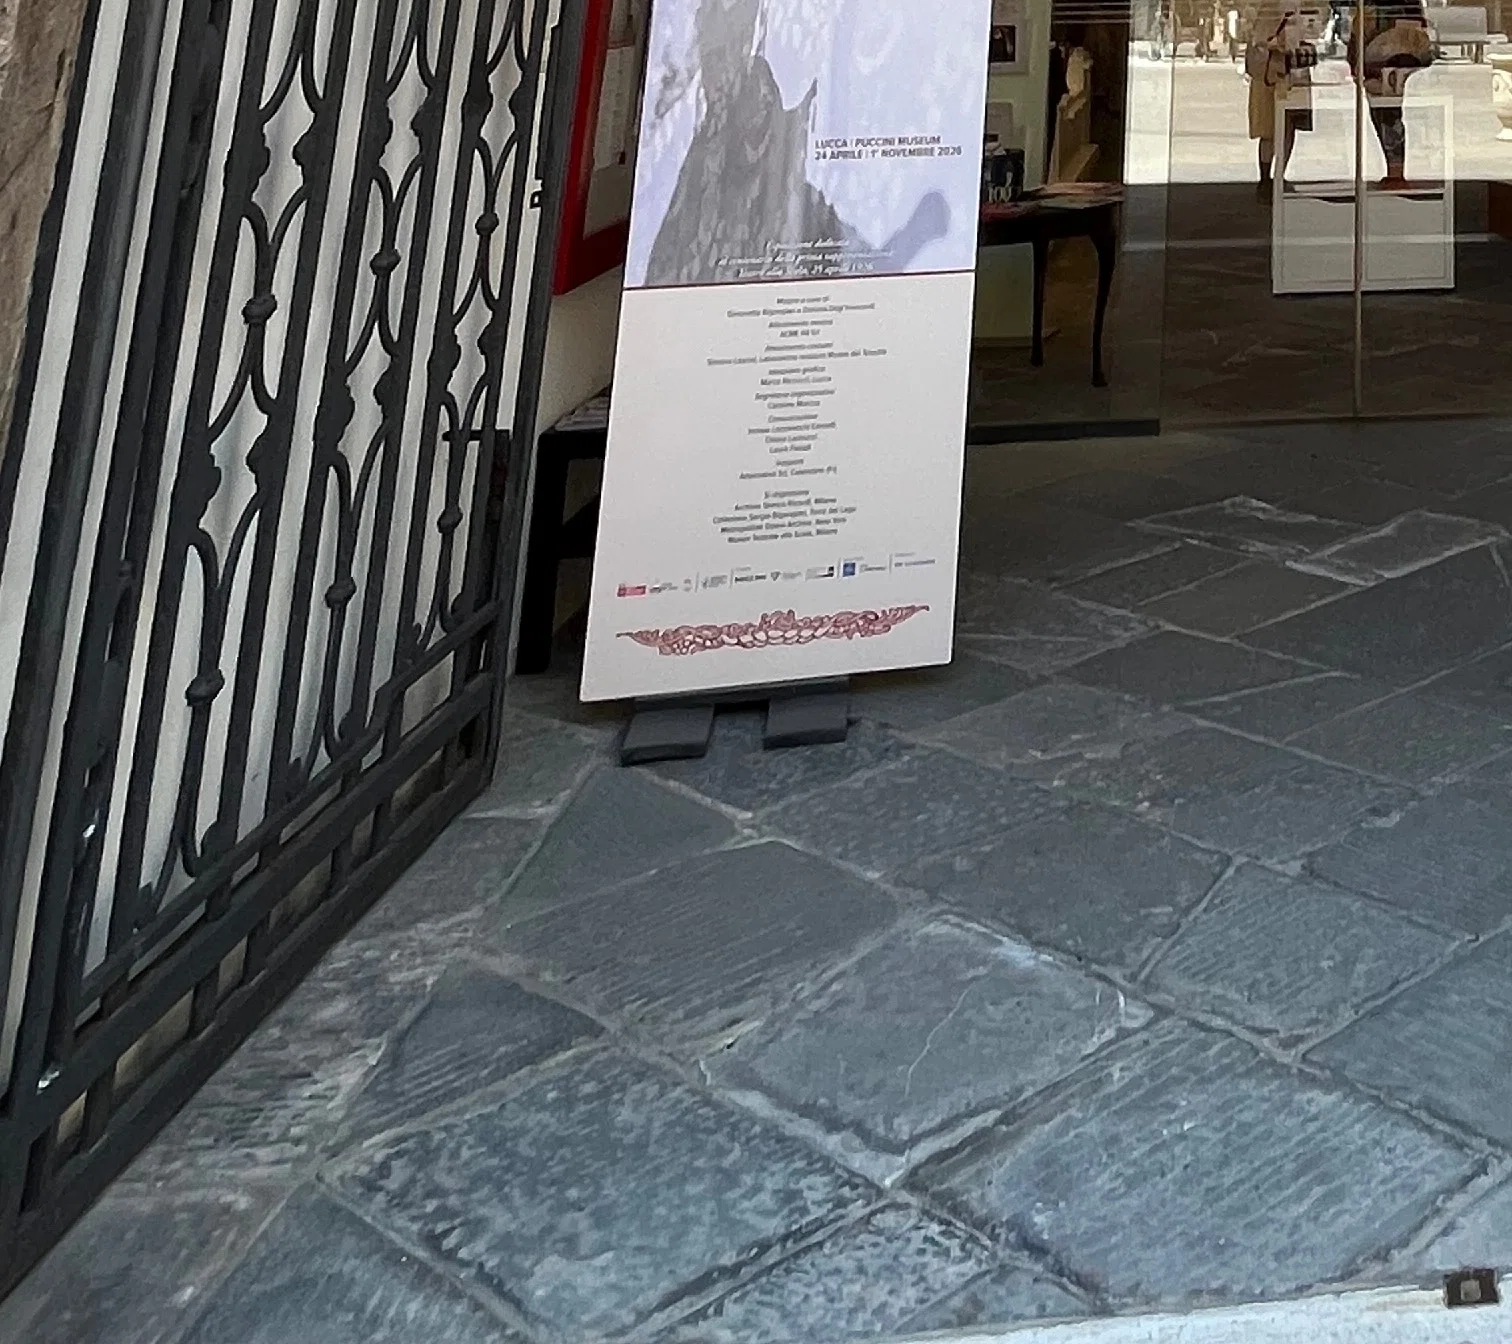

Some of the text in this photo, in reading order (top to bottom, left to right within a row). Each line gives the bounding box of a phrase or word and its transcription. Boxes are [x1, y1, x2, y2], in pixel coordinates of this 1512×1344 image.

[814, 135, 941, 149] LUCCA PUCCINI MUSEUM
[829, 149, 862, 160] APRILE
